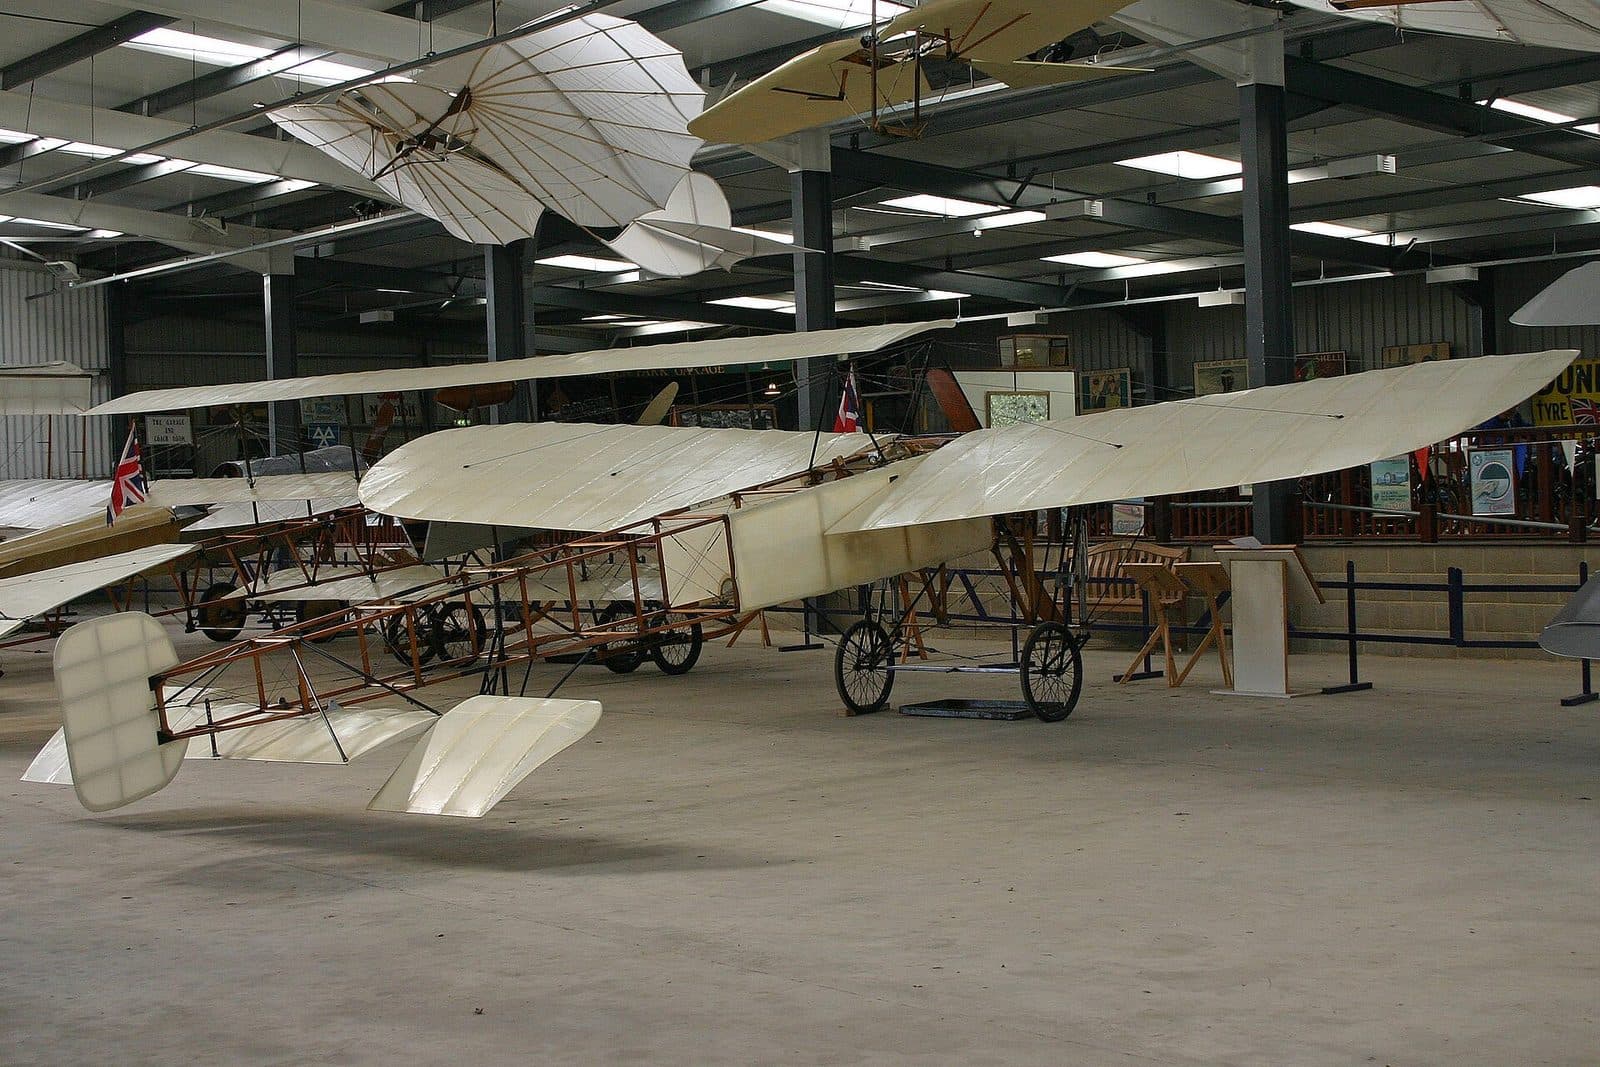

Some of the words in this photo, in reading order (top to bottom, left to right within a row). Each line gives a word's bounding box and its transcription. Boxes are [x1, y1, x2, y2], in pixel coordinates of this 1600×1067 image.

[674, 366, 725, 377] GARAGE
[1536, 365, 1600, 395] UN
[1536, 402, 1568, 421] TYRE
